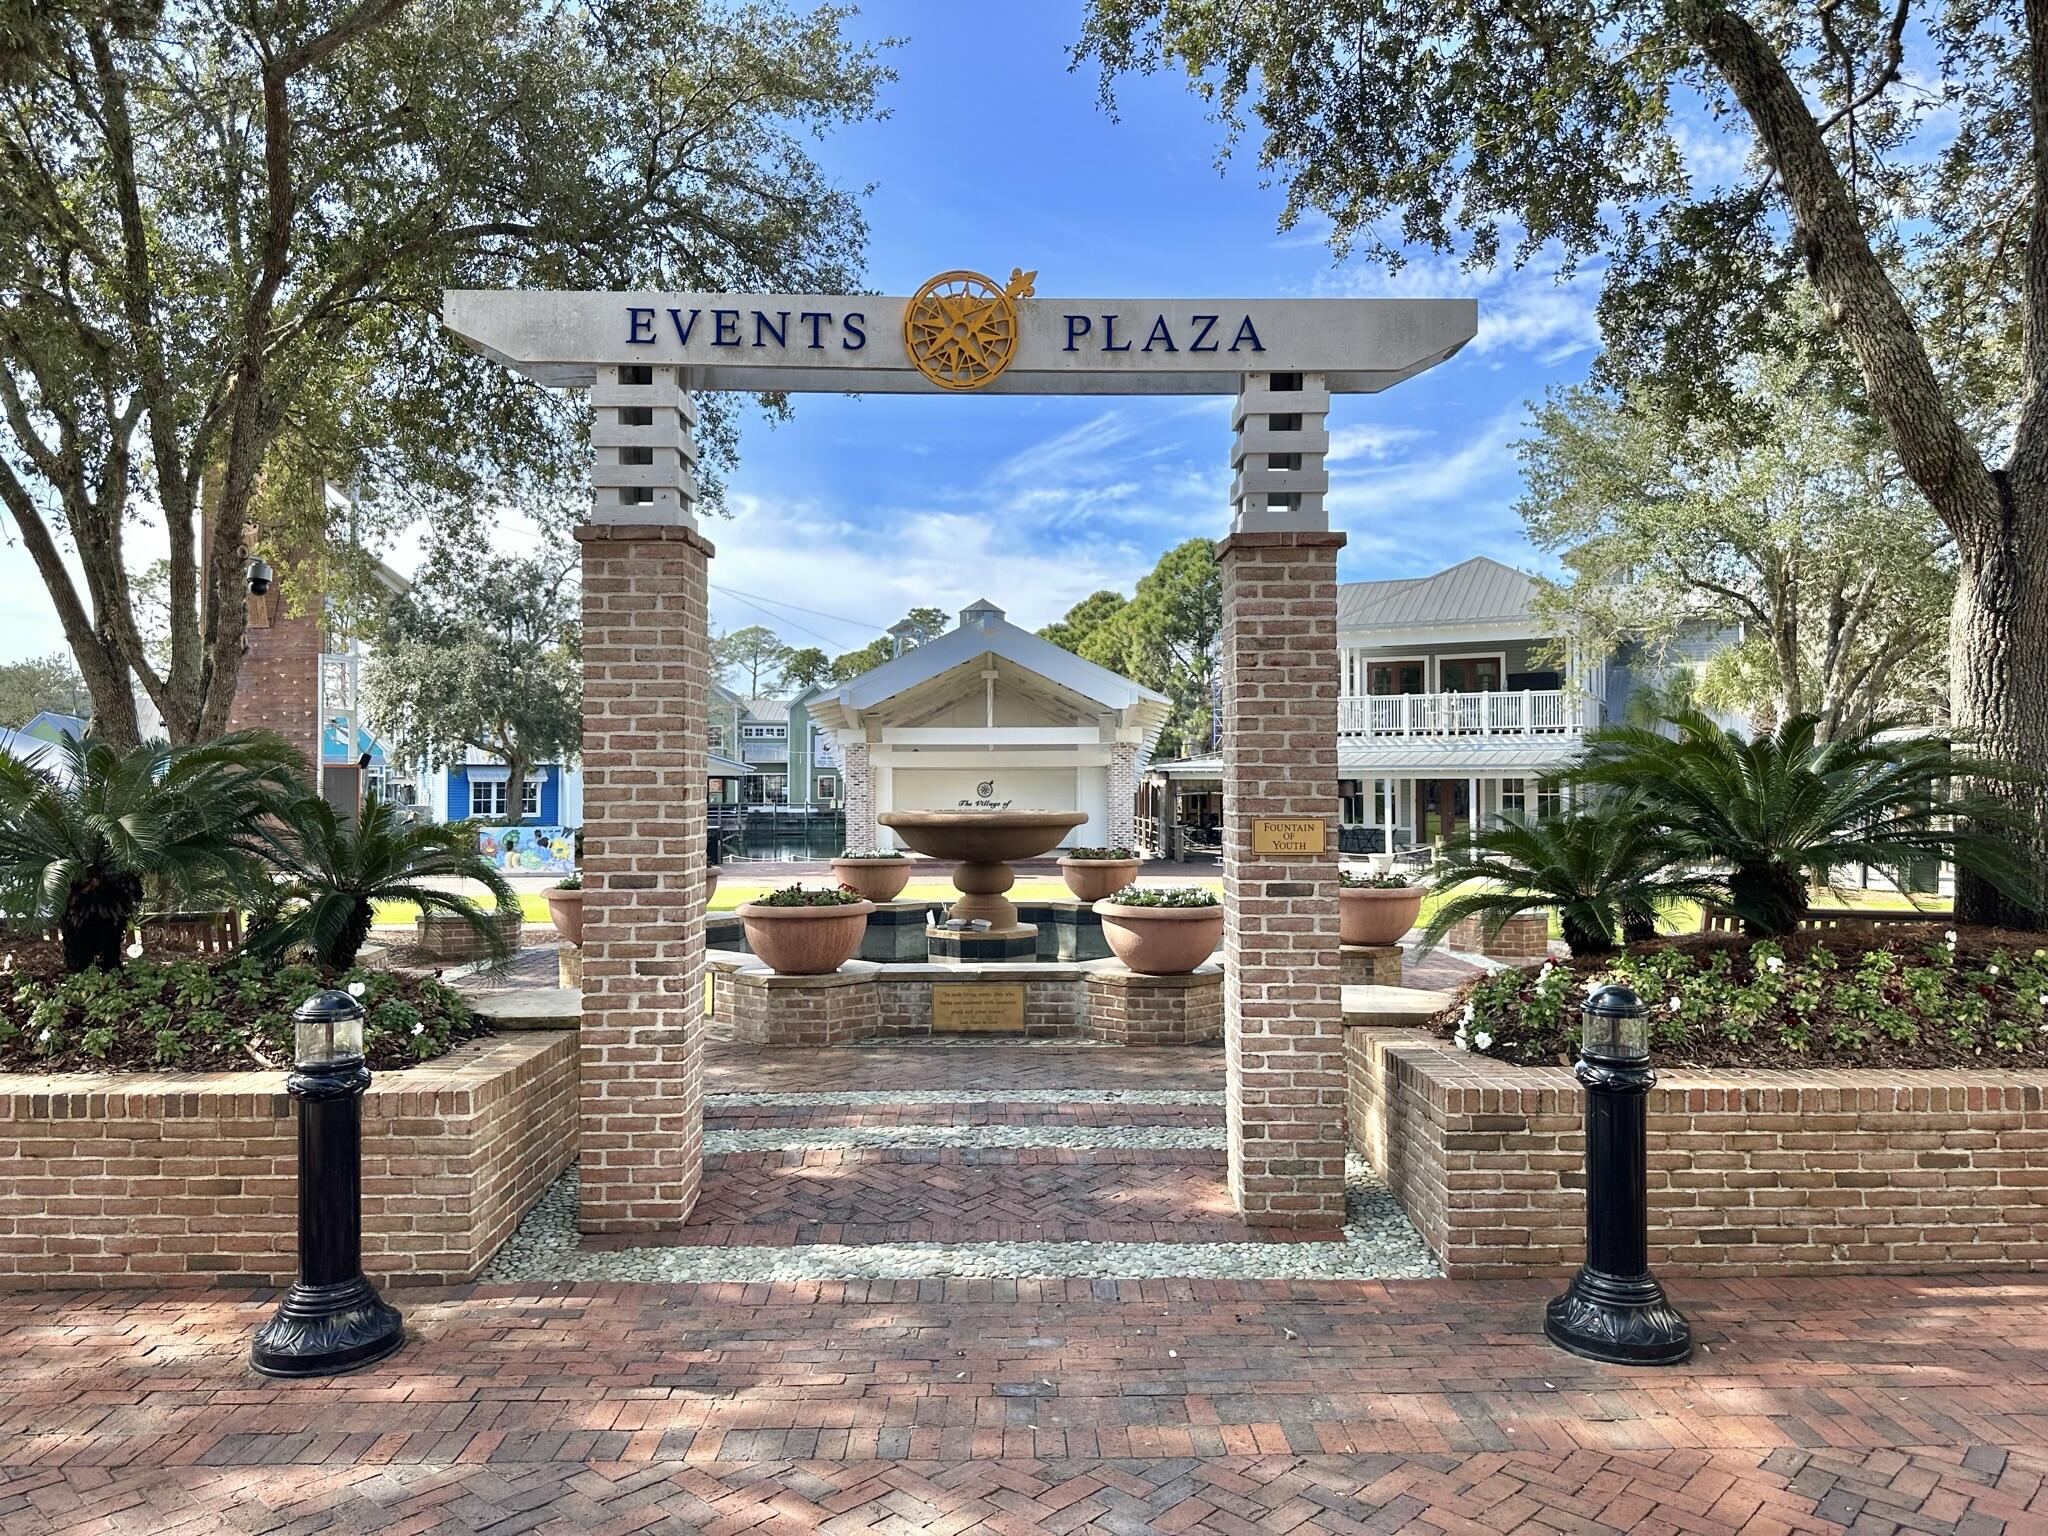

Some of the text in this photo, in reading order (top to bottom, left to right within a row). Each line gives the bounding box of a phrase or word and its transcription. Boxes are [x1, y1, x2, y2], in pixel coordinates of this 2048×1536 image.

[625, 307, 1267, 352] EVENTS PLAZA
[975, 800, 1001, 809] Village
[1002, 800, 1013, 809] of
[1263, 822, 1315, 832] FOUNTAIN
[1282, 832, 1295, 840] OF
[1272, 840, 1307, 850] YOUTH
